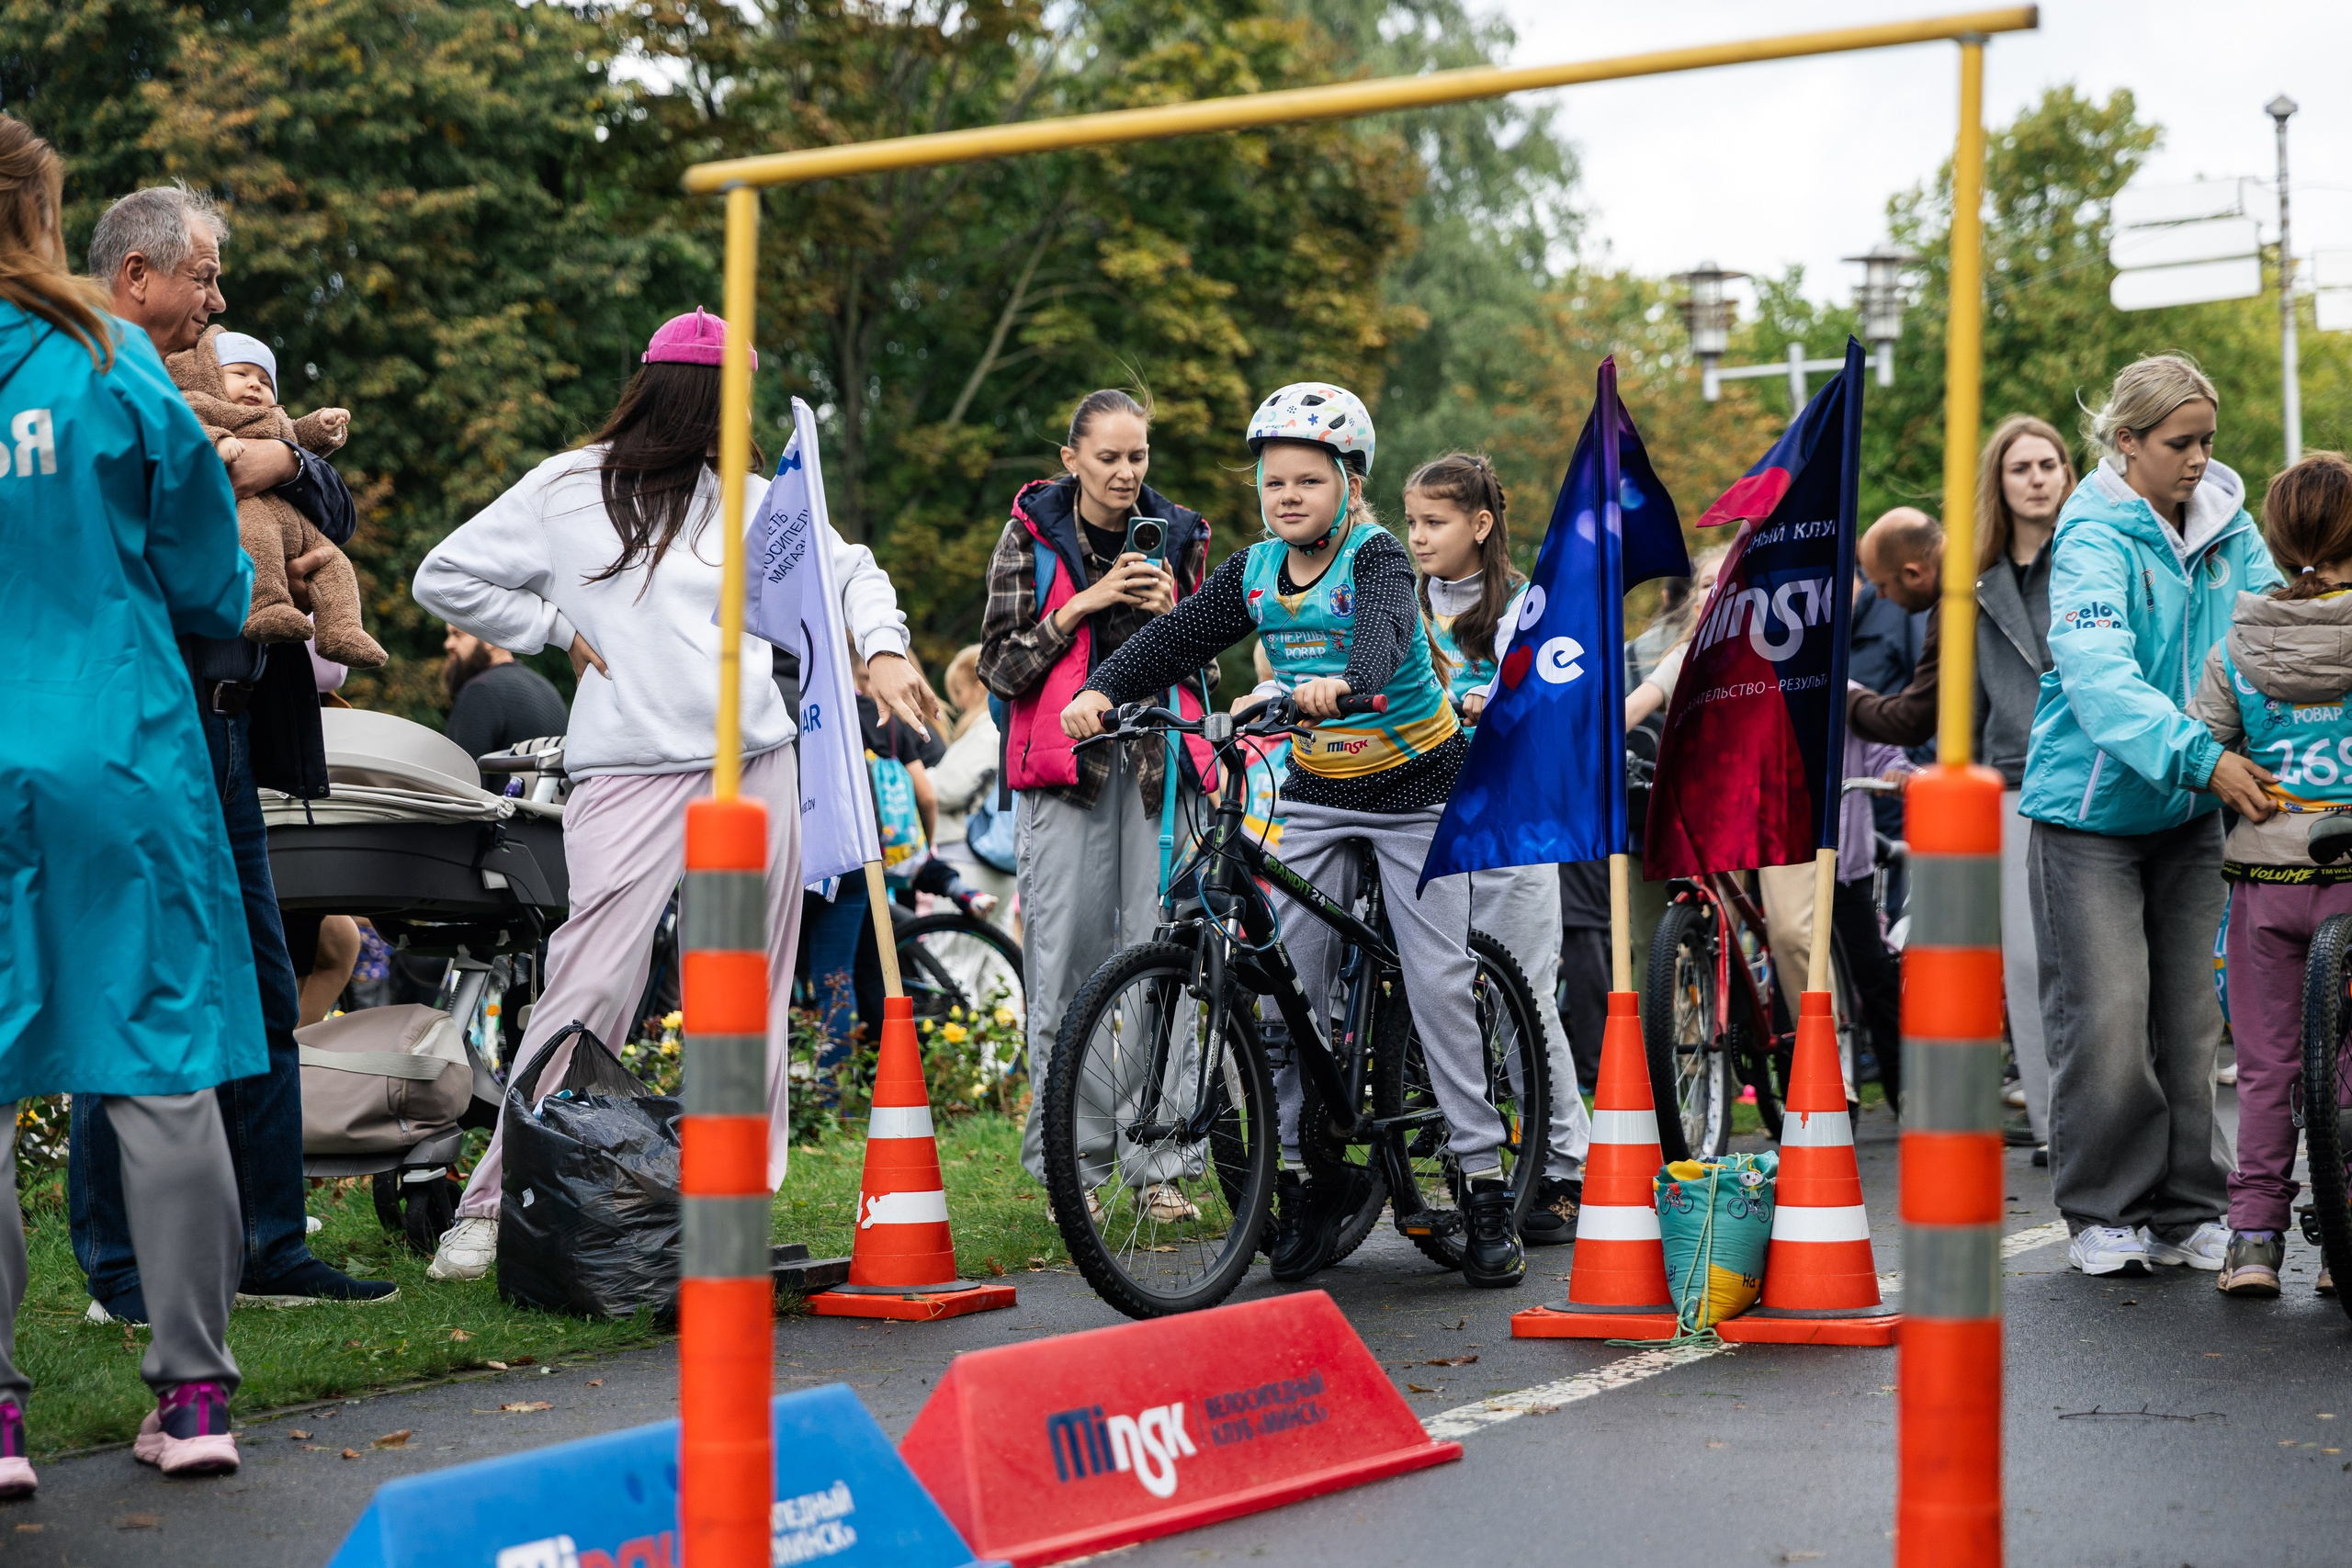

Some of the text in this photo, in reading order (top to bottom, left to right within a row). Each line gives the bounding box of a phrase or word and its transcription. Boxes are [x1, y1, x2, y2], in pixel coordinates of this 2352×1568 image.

[1284, 647, 1327, 660] РОВАР
[2292, 706, 2343, 725] РОВАР
[1268, 856, 1313, 897] BANDIT
[1311, 888, 1329, 908] 24
[2249, 867, 2317, 884] VOLUME
